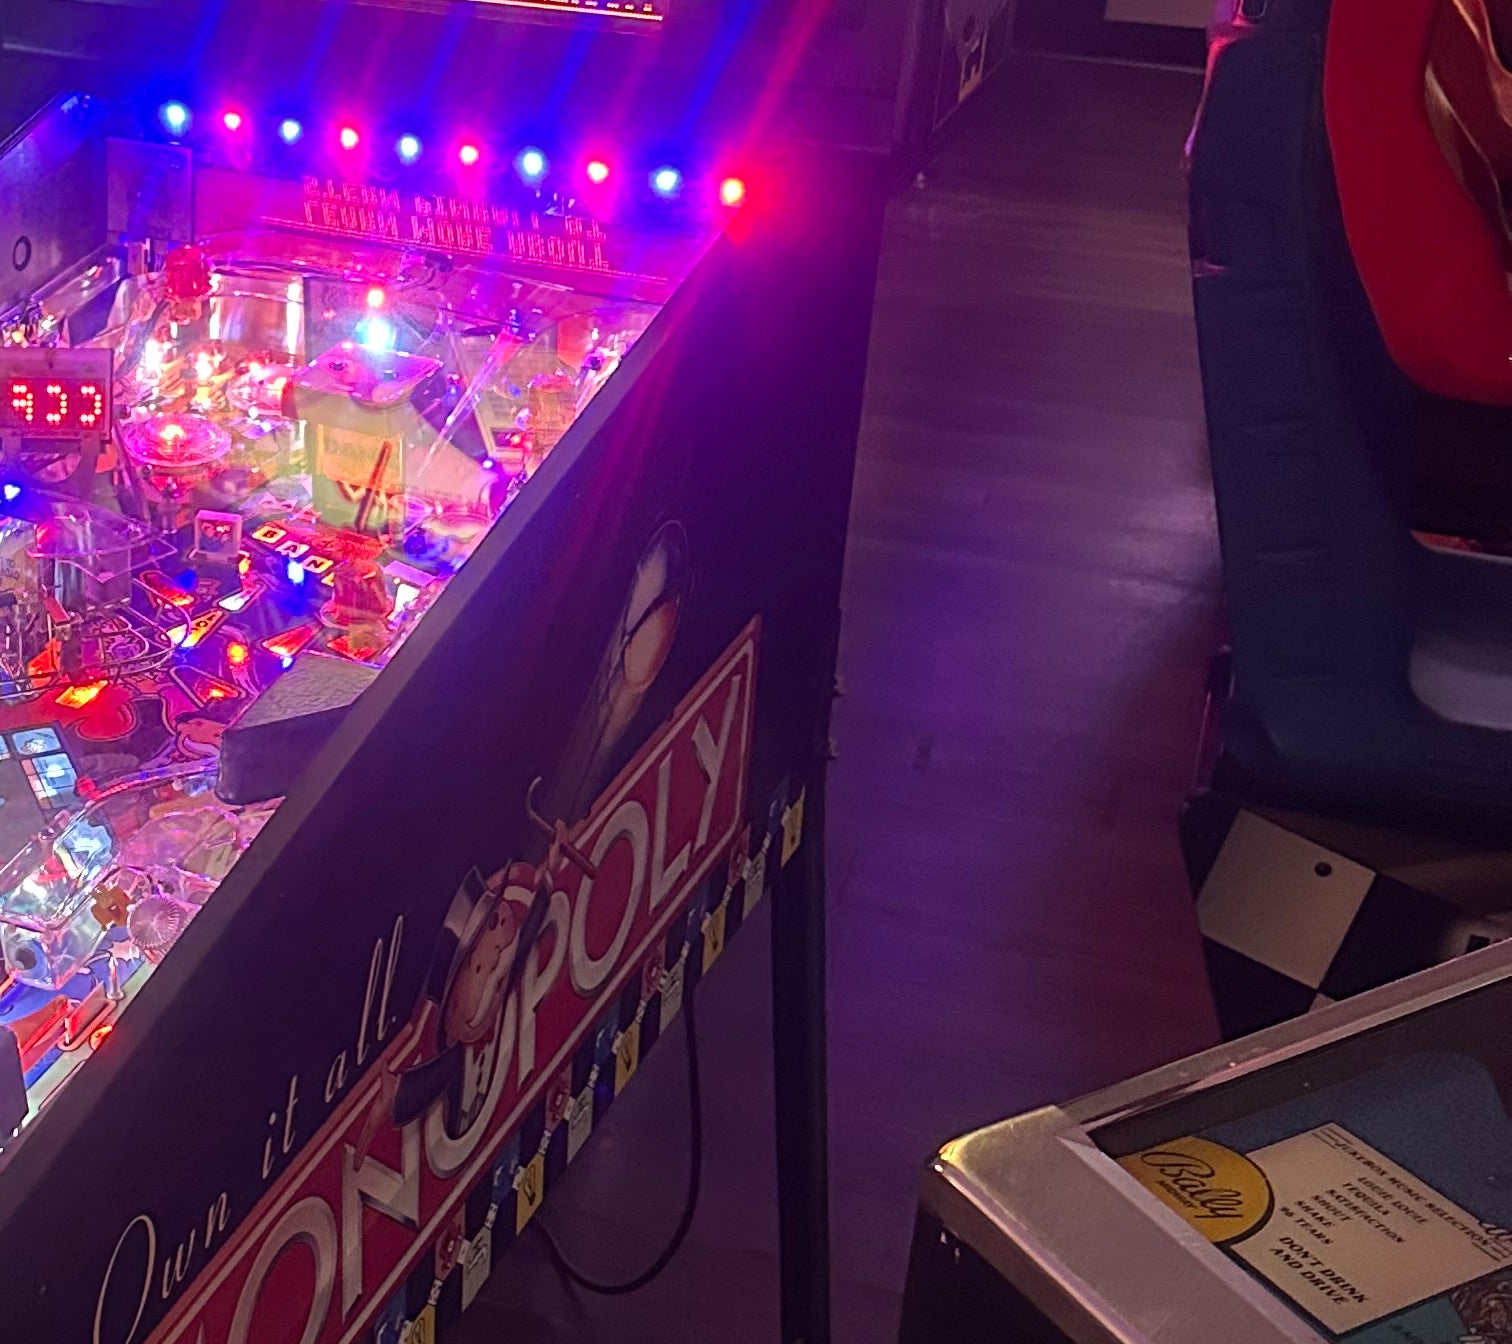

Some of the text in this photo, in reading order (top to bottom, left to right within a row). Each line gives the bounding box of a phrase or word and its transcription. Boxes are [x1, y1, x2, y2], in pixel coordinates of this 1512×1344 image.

[262, 1073, 300, 1179] it
[1139, 1151, 1245, 1220] Bally
[1310, 1193, 1353, 1223] SHOUT
[1340, 1181, 1391, 1217] TEQUILA
[1356, 1175, 1430, 1225] LOUIE LOUIE
[1388, 1174, 1426, 1202] MUSIC
[1293, 1199, 1337, 1230] SHAKE
[1293, 1214, 1335, 1246] TEARS
[1324, 1188, 1406, 1245] SATISFACTION
[1268, 1246, 1352, 1307] AND DRIVE
[1278, 1235, 1371, 1304] DON'T DRINK
